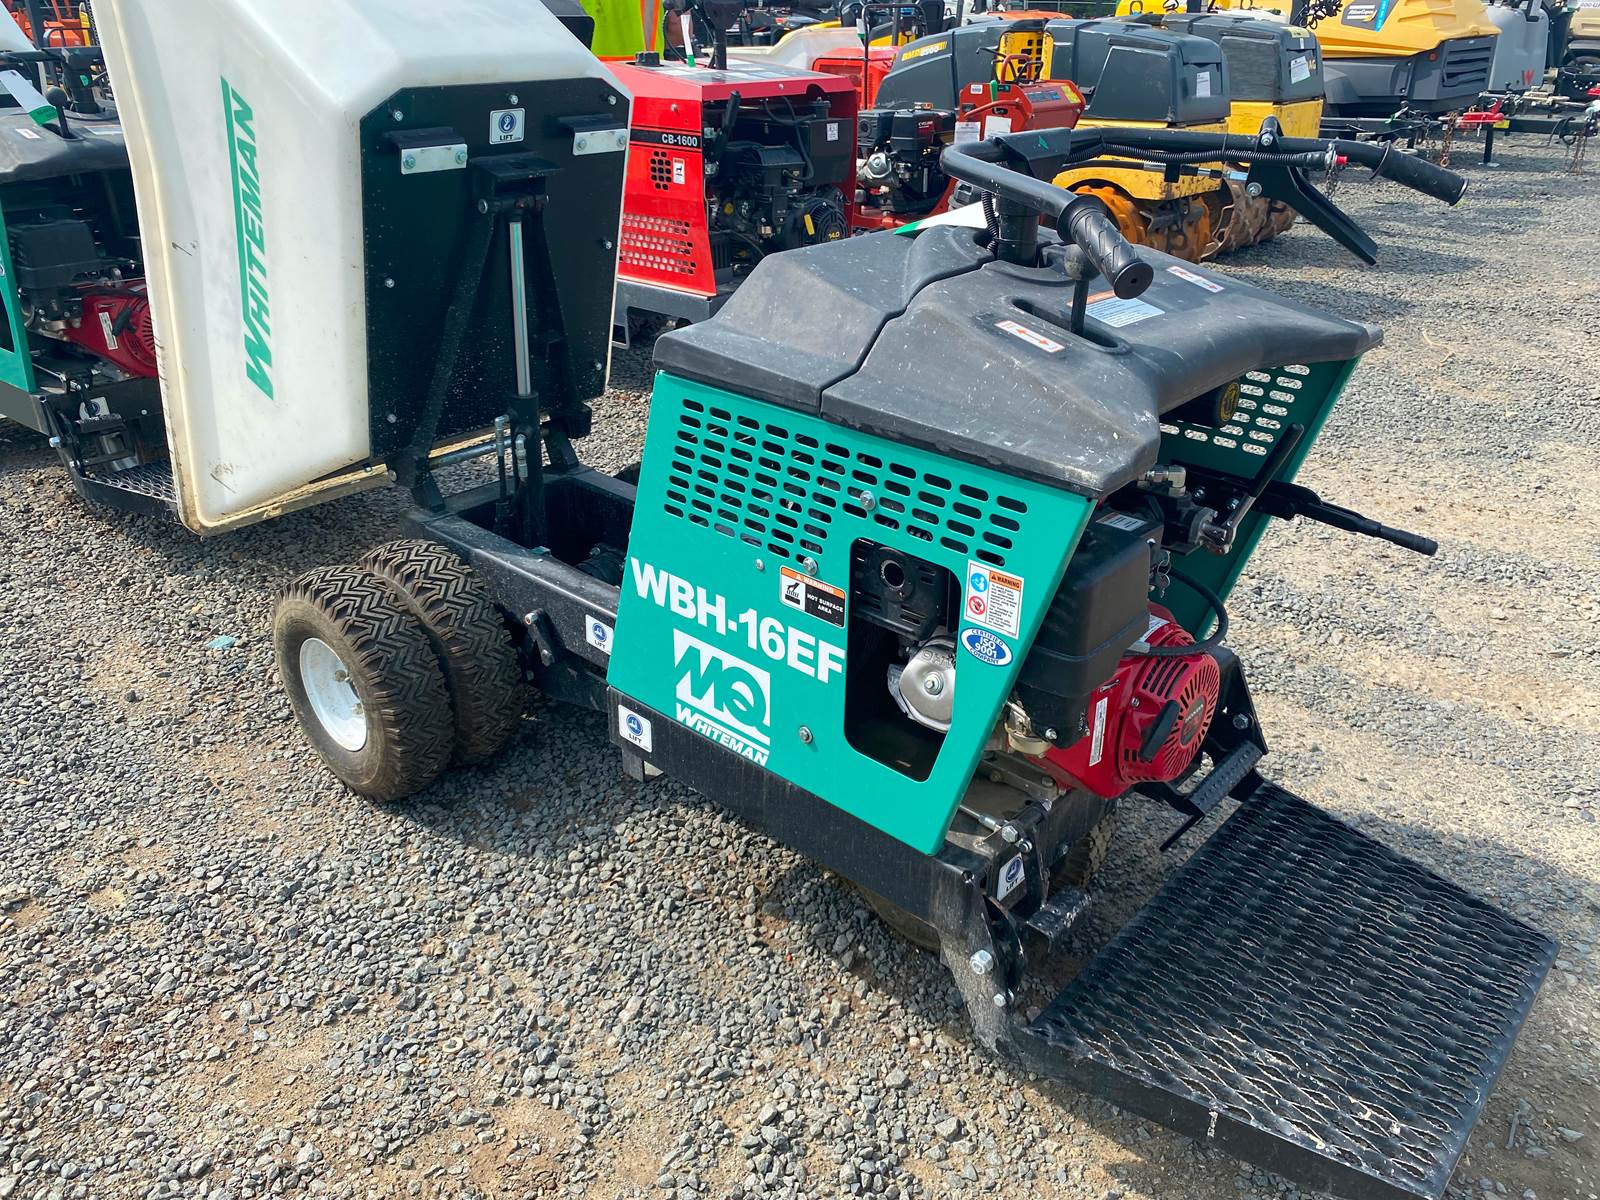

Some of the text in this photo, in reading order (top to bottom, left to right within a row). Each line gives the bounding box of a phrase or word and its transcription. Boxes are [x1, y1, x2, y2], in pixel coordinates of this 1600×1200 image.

[661, 134, 698, 147] CB-1600
[221, 75, 274, 401] WHITEMAN
[803, 576, 834, 594] WARNING
[997, 575, 1020, 589] WARNING
[806, 593, 844, 613] HOT SURFACE
[817, 604, 833, 615] AREA
[630, 556, 846, 684] WBH-16EF
[594, 640, 606, 649] LIFT
[971, 629, 1005, 647] CERTIFIED
[980, 636, 996, 650] ISO
[969, 648, 999, 664] COMPANY
[974, 643, 998, 658] 9001
[628, 732, 642, 744] LIFT
[675, 702, 770, 767] WHITEMAN
[1006, 877, 1019, 891] LIFT
